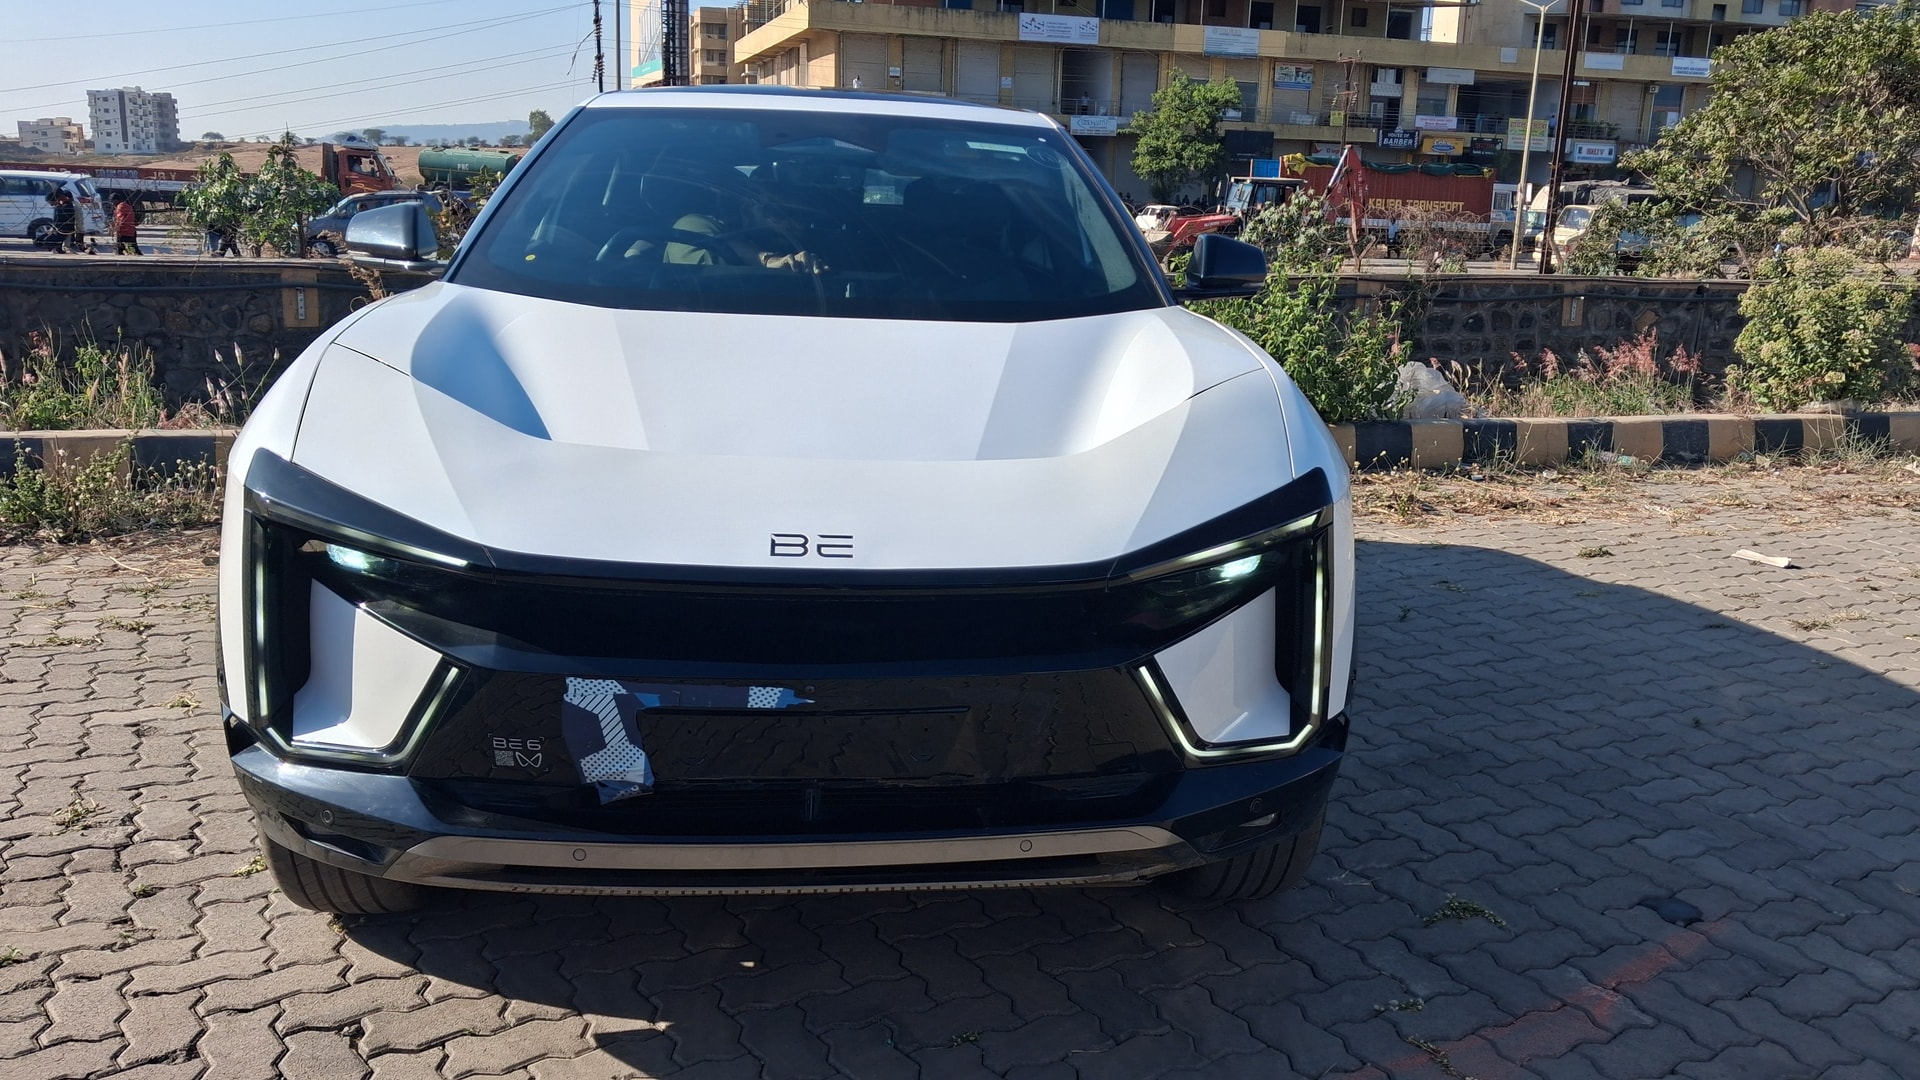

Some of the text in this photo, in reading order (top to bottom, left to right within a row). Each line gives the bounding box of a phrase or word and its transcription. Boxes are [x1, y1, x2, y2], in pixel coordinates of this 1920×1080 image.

[1383, 137, 1413, 146] BARBER
[1406, 199, 1464, 213] TRANSPORT
[770, 533, 853, 558] BE
[493, 737, 541, 750] BE 6
